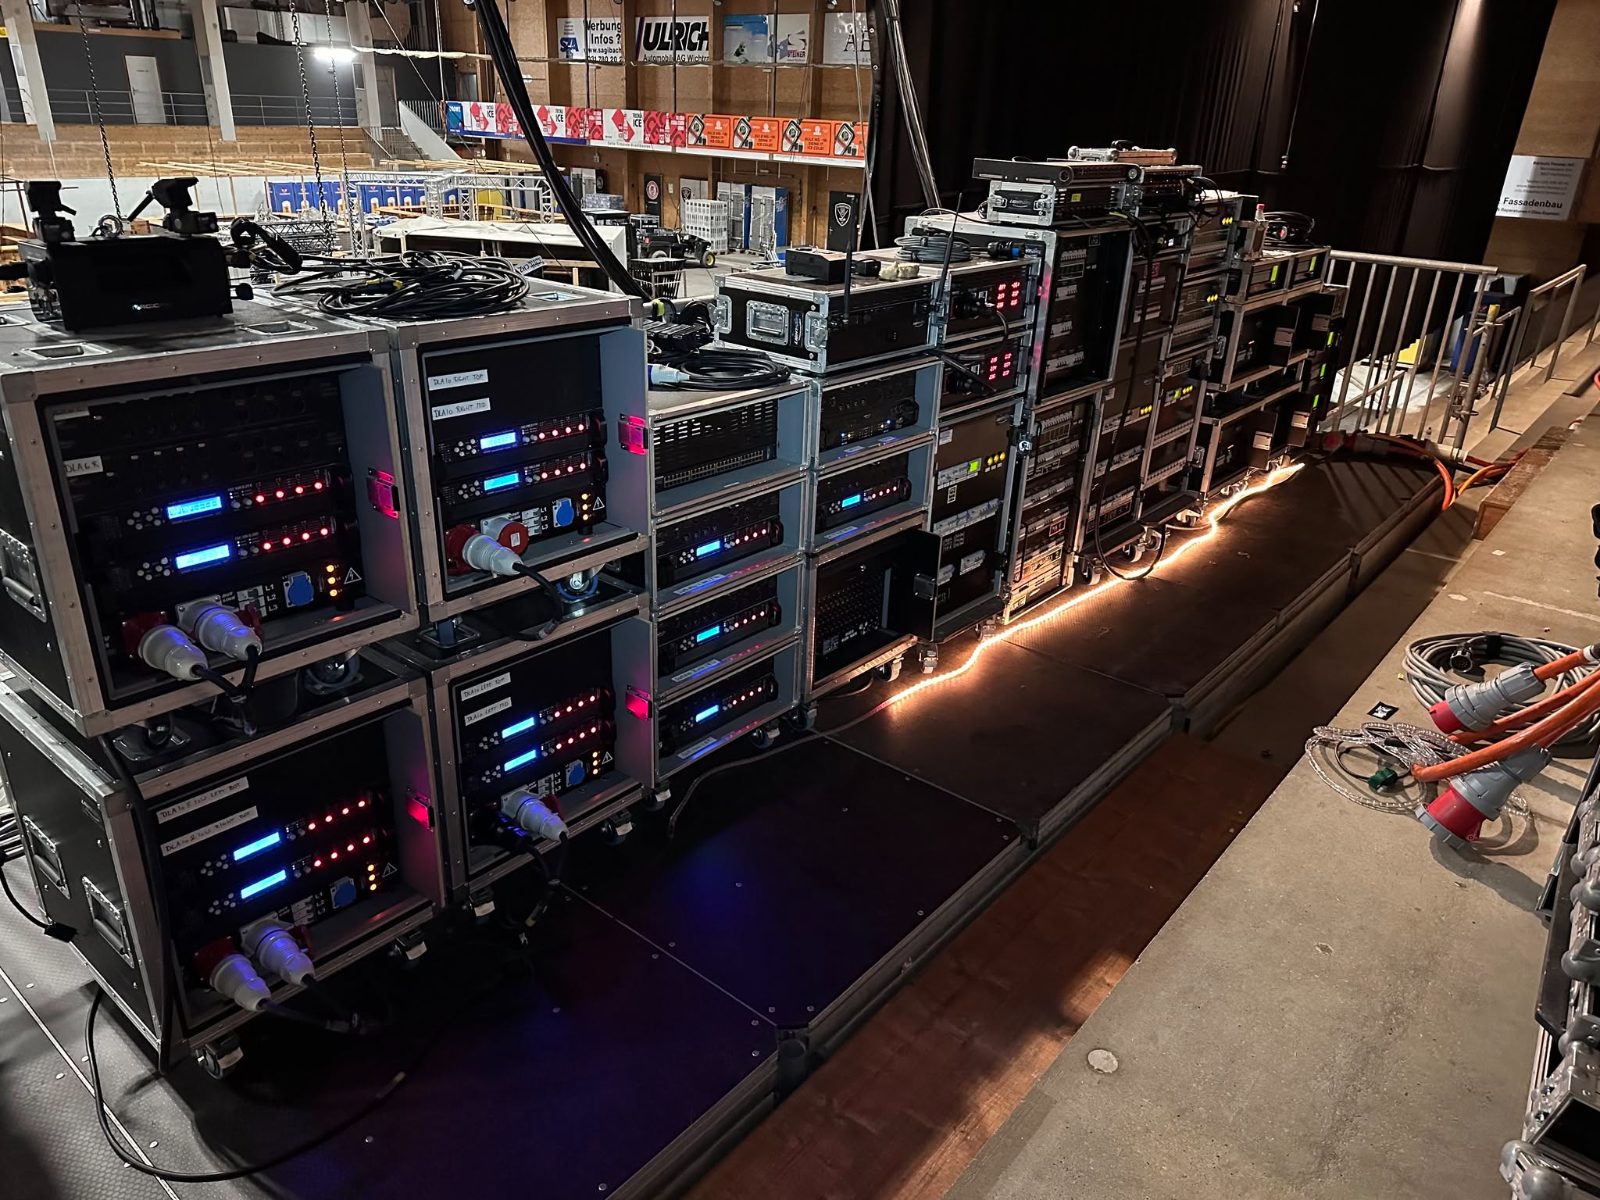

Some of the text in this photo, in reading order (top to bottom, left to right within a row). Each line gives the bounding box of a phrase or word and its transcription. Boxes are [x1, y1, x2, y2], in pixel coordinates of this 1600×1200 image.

[591, 33, 622, 45] Infos ?
[642, 21, 709, 51] ULRICH
[676, 54, 686, 63] AG
[487, 110, 495, 118] ICE
[555, 114, 564, 123] ICE
[633, 119, 642, 128] ICE
[1503, 197, 1563, 209] Fassadenbau
[265, 584, 275, 592] L1
[268, 604, 278, 612] L3
